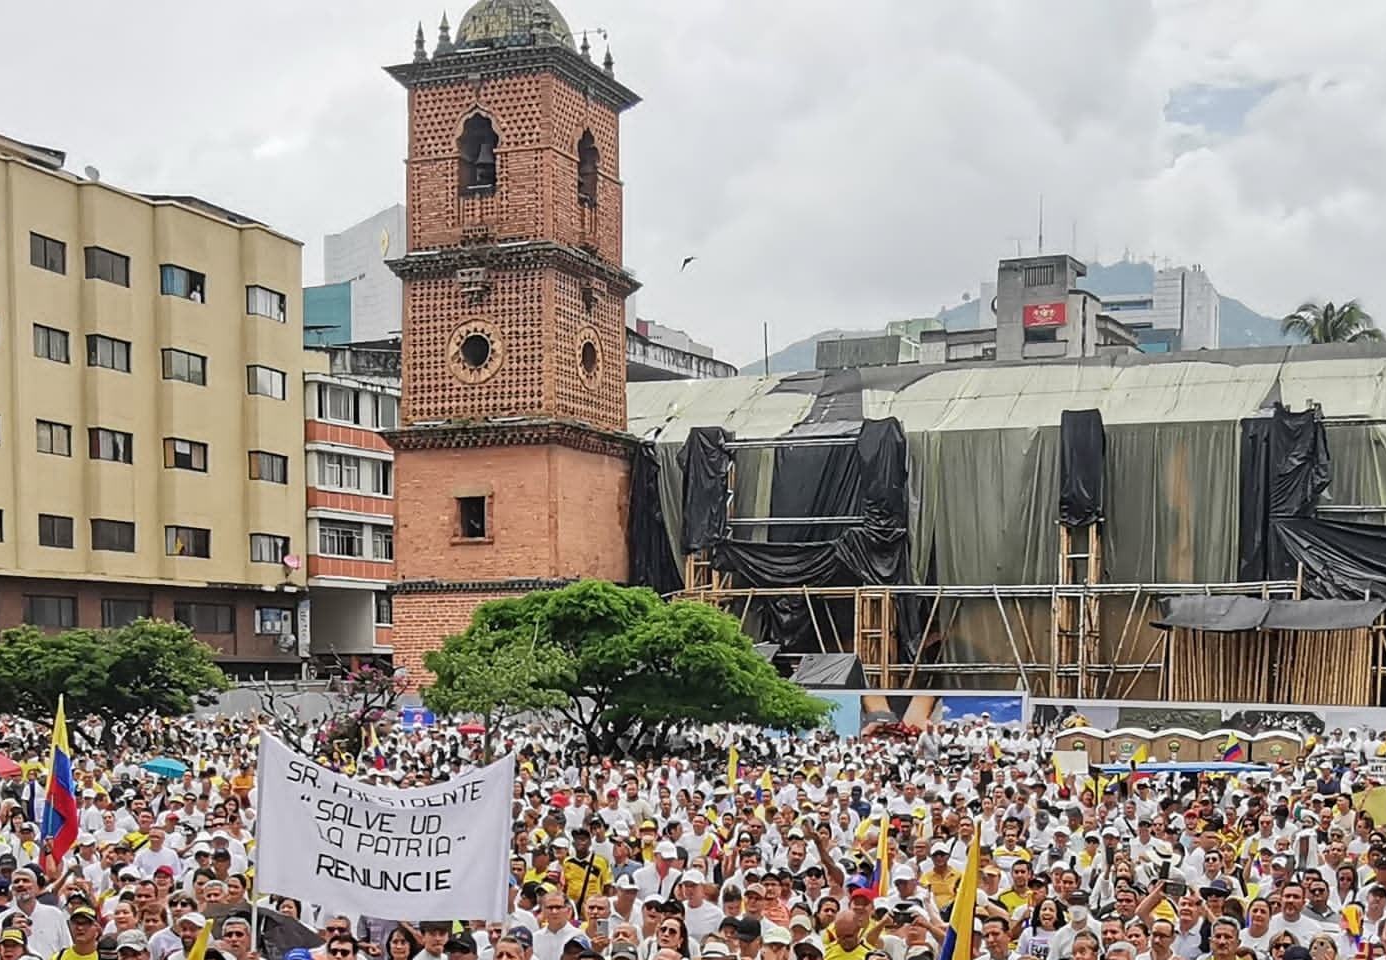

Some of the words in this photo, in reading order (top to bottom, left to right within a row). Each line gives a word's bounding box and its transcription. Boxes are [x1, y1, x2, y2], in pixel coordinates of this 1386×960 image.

[286, 760, 322, 789] SR.
[411, 814, 443, 836] UD
[315, 853, 453, 893] RENUNCIE
